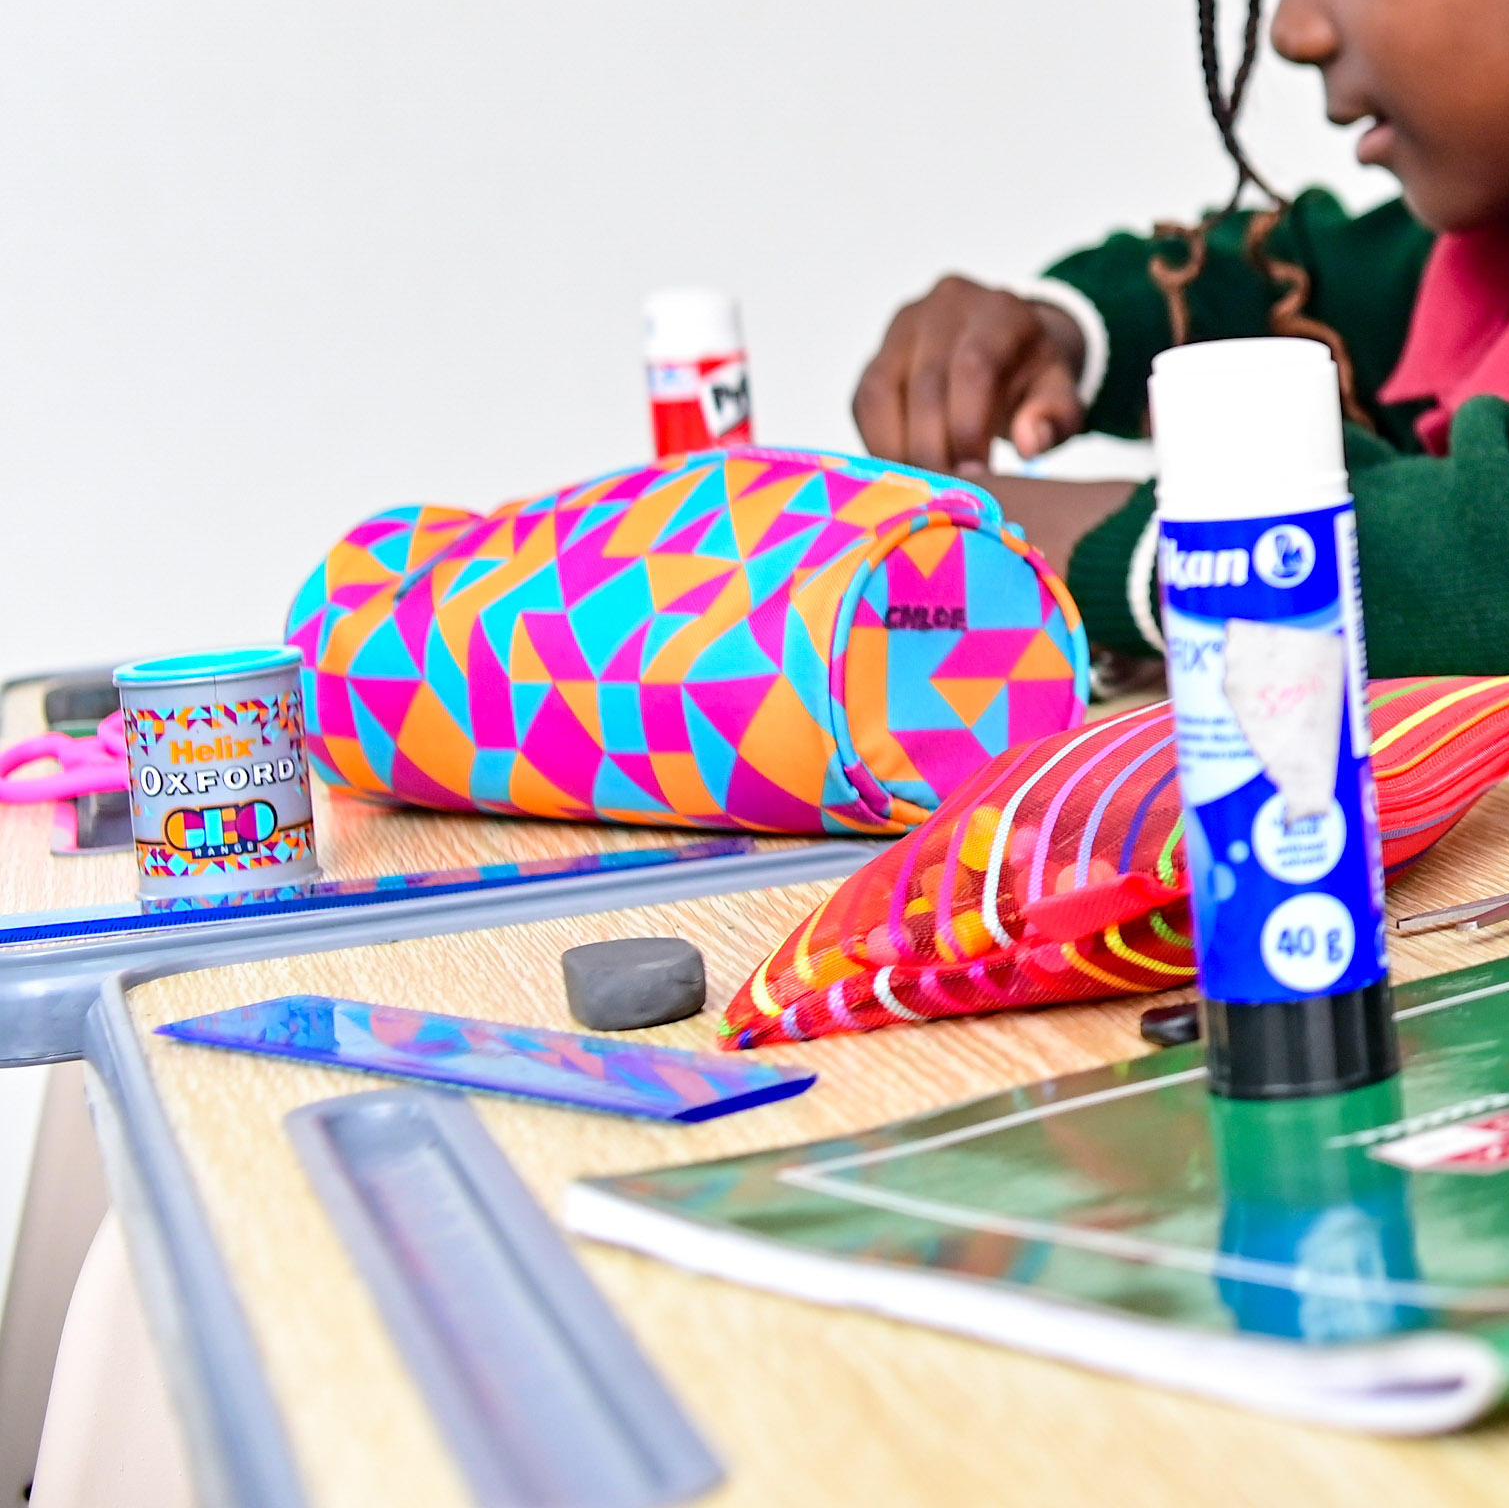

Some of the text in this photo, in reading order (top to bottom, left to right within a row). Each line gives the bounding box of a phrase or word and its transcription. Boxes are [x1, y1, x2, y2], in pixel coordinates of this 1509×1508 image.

[885, 604, 968, 632] CHLOE
[170, 735, 256, 764] Helix
[140, 758, 296, 797] OXFORD
[164, 800, 279, 852] GEO
[193, 842, 257, 859] RANGE
[1276, 924, 1344, 965] 40 g
